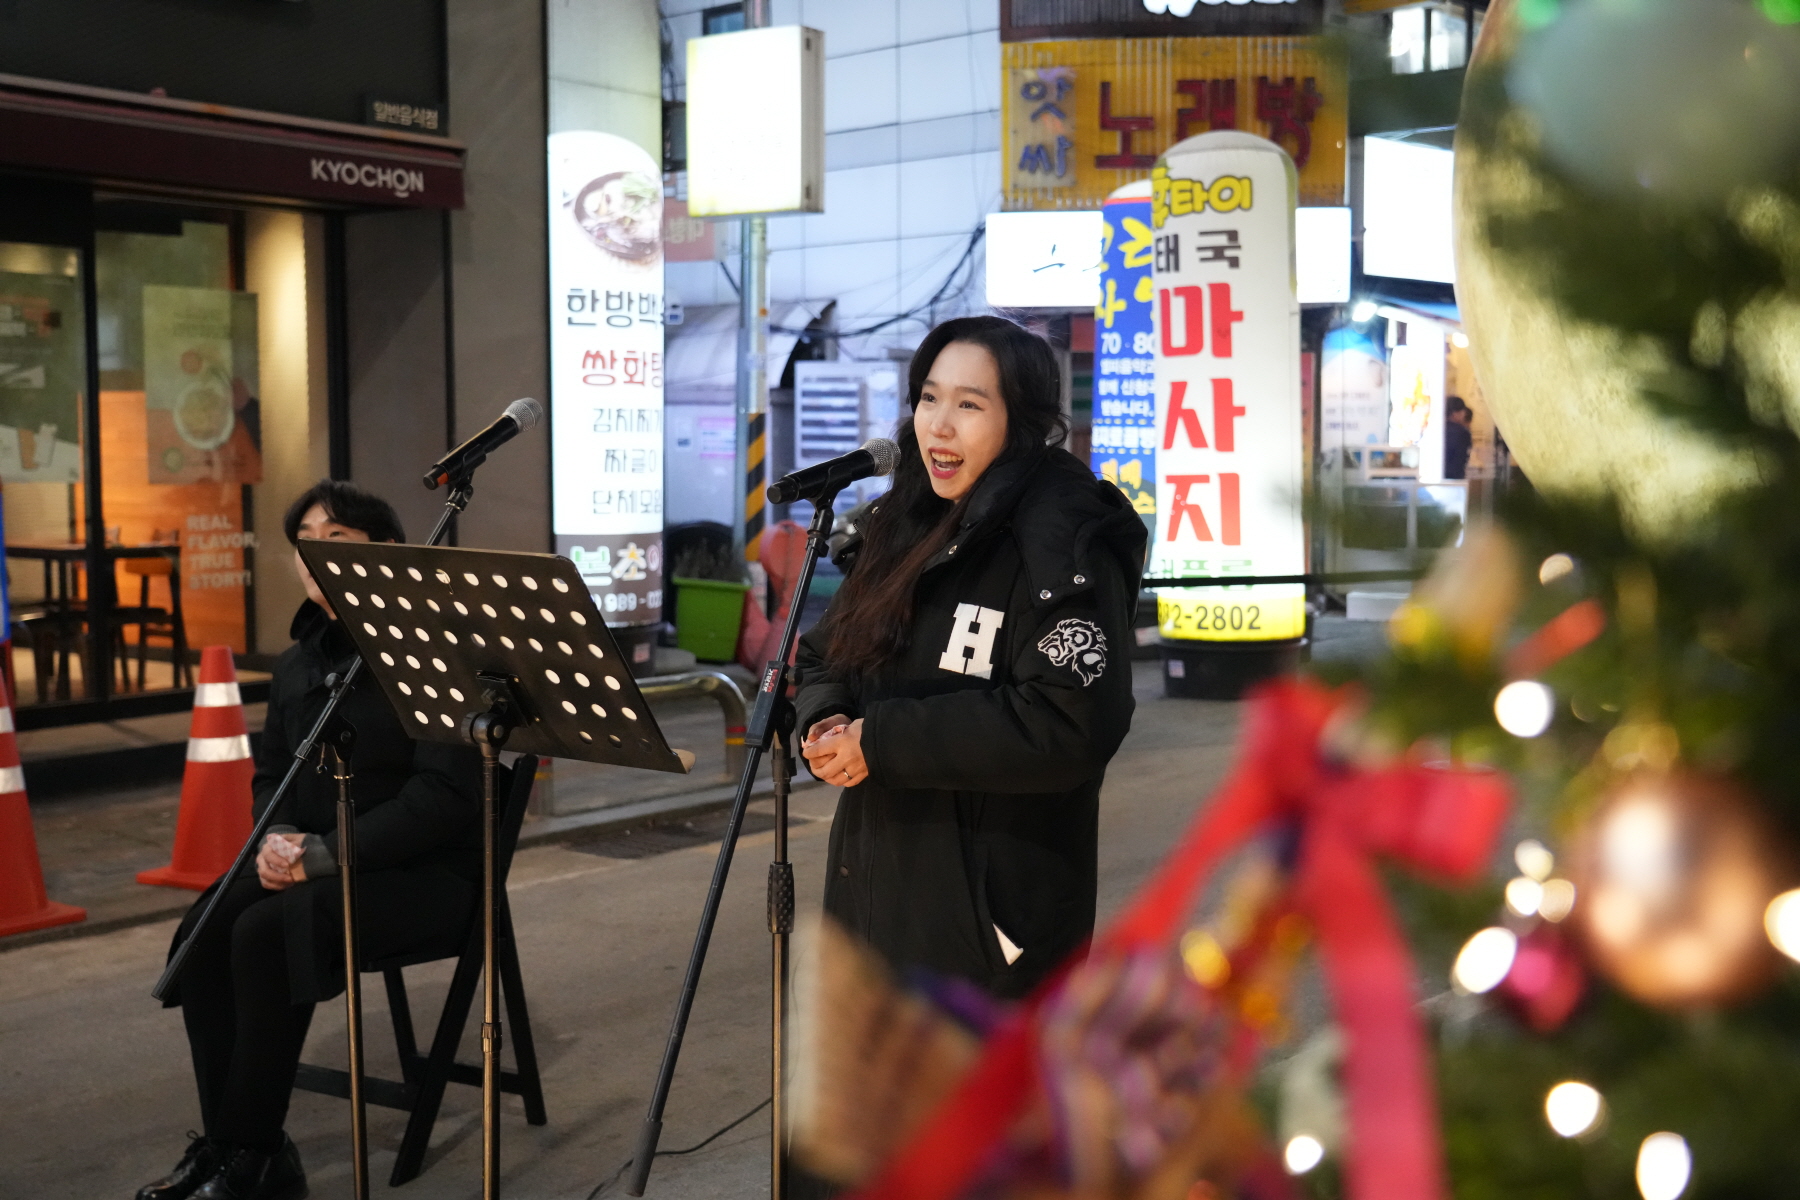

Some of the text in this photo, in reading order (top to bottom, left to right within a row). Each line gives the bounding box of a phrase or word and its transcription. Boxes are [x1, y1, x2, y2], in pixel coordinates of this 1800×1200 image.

[373, 101, 439, 130] 일반음식점
[1094, 75, 1325, 170] 노래방
[311, 158, 424, 198] KYOCHON
[1155, 230, 1242, 272] 태국
[566, 288, 664, 328] 한방백
[1160, 282, 1246, 546] 마사지
[186, 514, 233, 532] REAL
[187, 531, 260, 550] FLAVOR,
[189, 552, 235, 571] TRUE
[938, 602, 1005, 680] H
